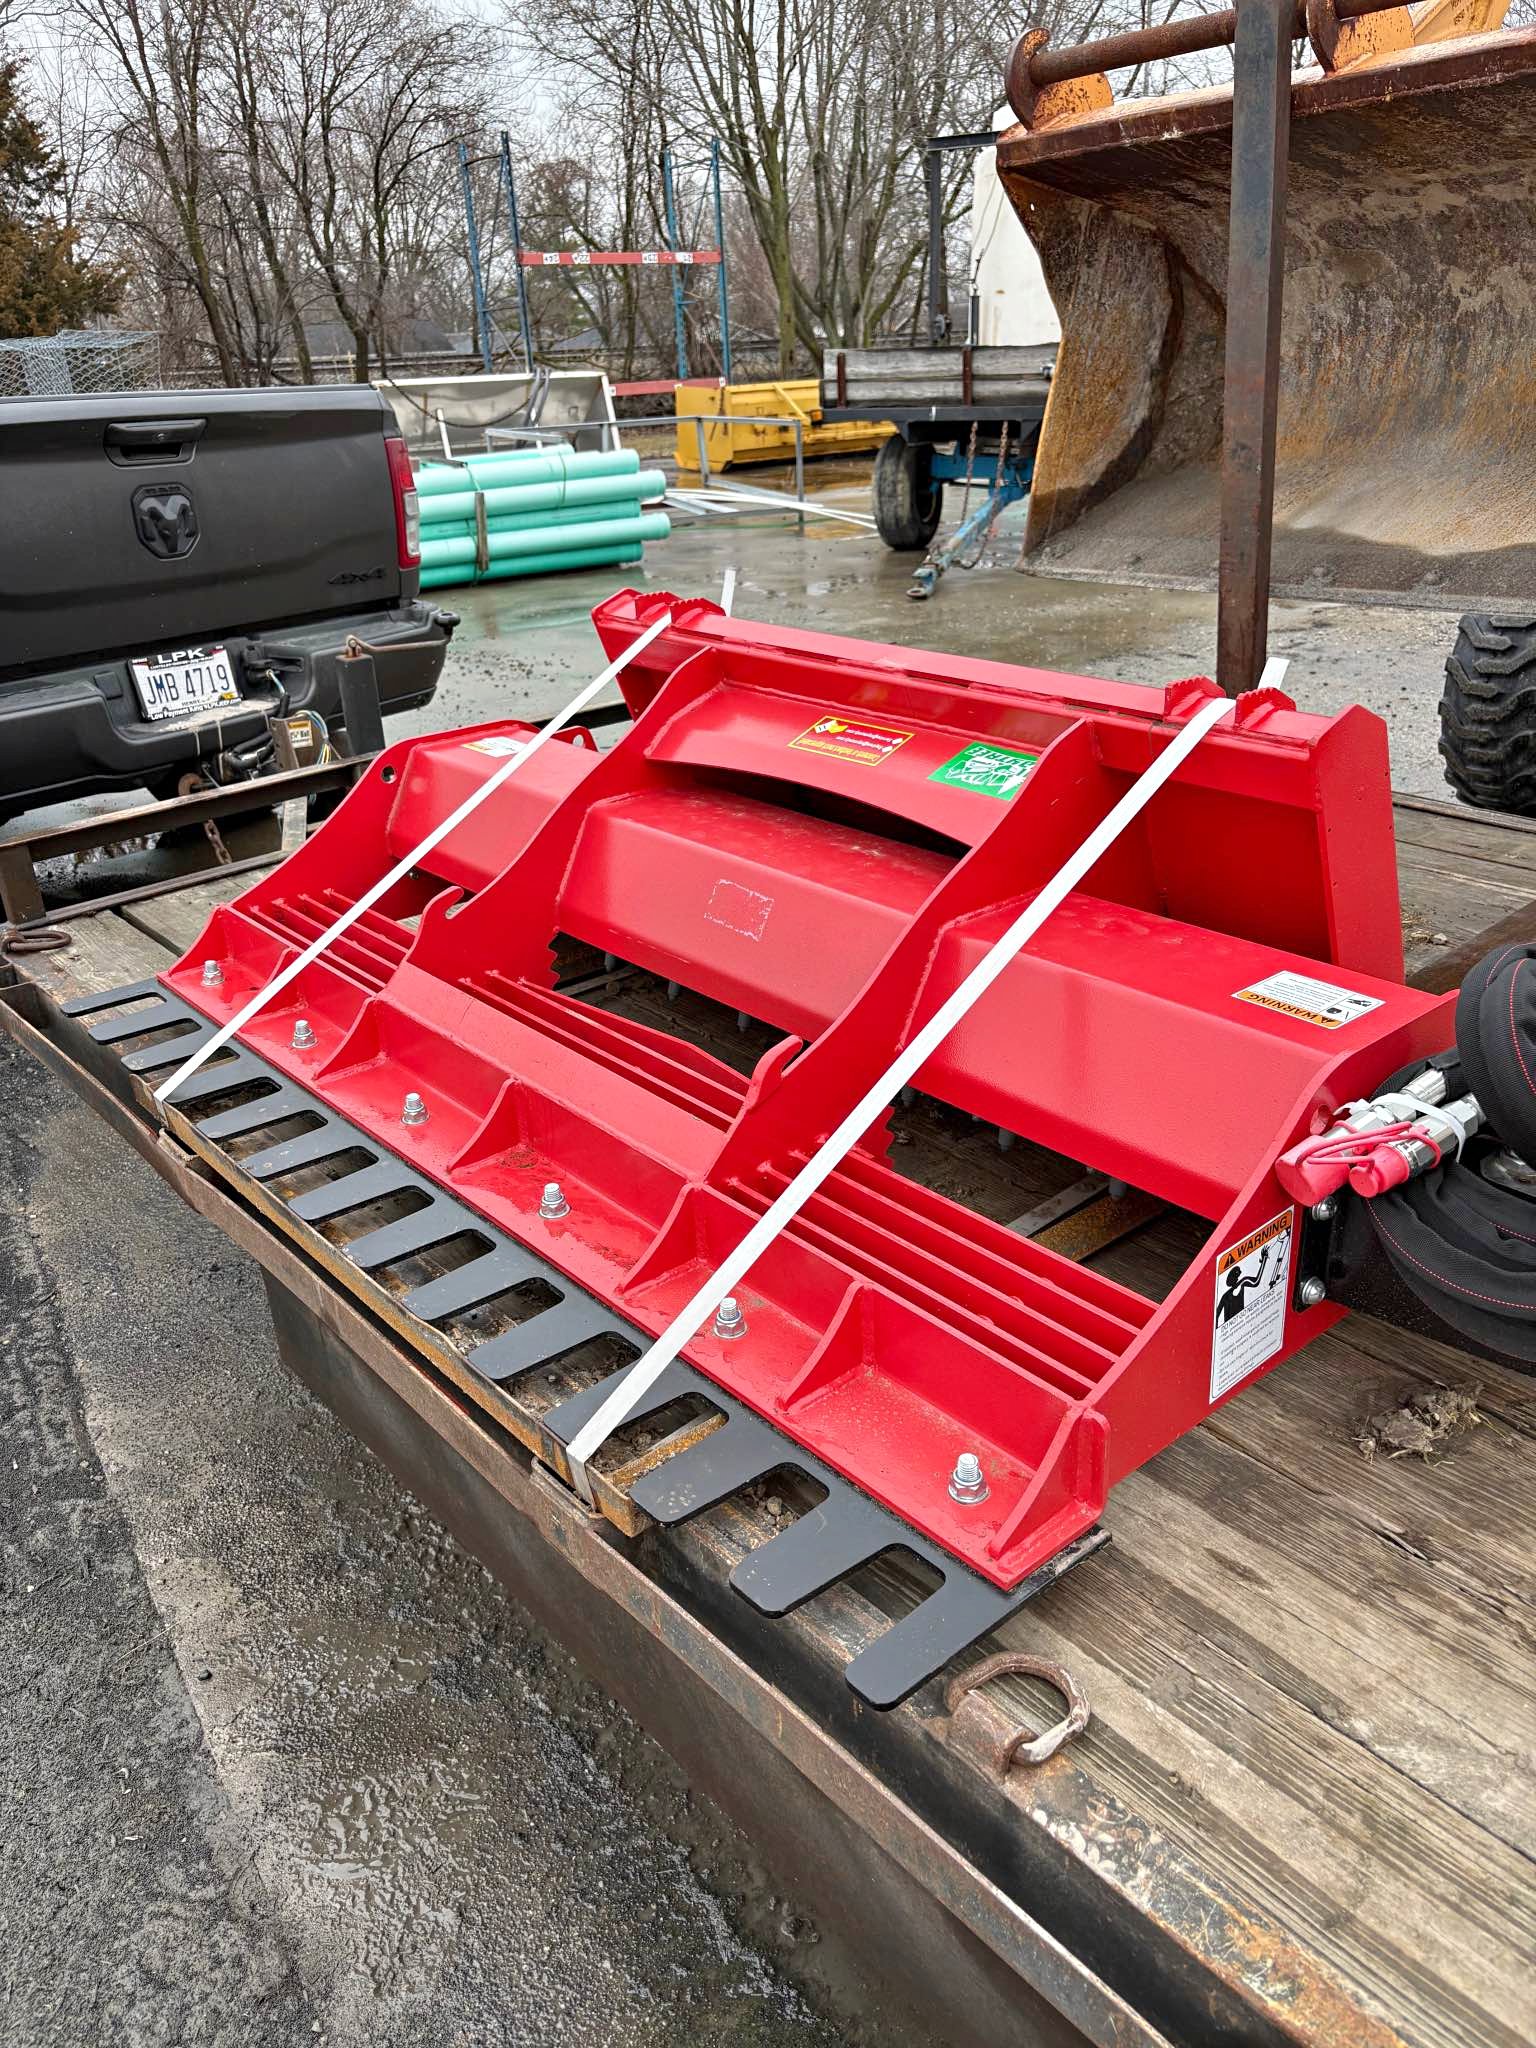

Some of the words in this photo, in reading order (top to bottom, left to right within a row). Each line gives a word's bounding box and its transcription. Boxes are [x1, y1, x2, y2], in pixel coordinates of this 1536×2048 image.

[157, 649, 205, 664] LPK
[147, 673, 179, 706] JMB
[186, 664, 230, 698] 4719
[1248, 994, 1315, 1020] WARNING
[1237, 1216, 1287, 1258] WARNING
